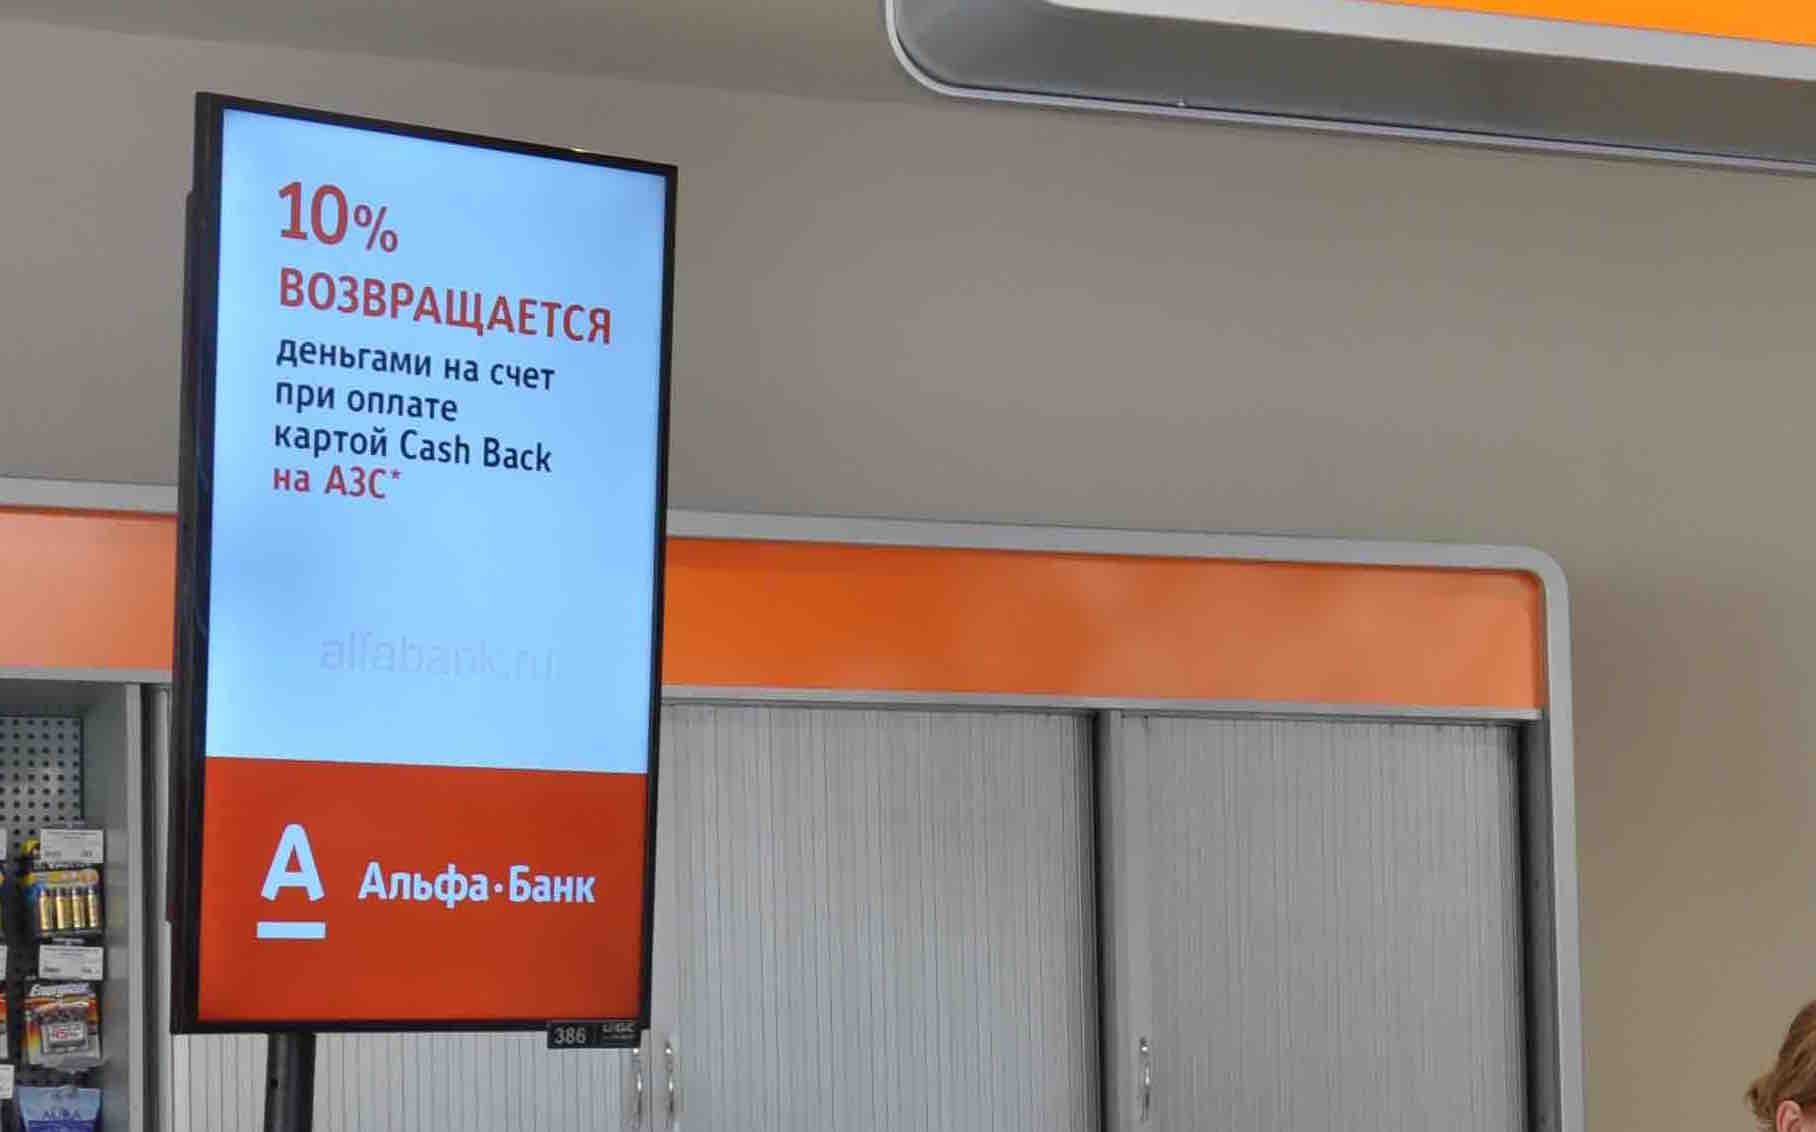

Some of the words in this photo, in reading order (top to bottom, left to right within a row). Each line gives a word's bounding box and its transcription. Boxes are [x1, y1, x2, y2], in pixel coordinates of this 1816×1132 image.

[277, 181, 398, 252] 10%
[278, 267, 613, 345] ВОЗВРАЩАЕТСЯ
[275, 338, 432, 379] деньгами
[443, 349, 480, 383] на
[490, 360, 555, 391] счет
[275, 381, 335, 416] при
[346, 390, 459, 422] оплате
[274, 423, 389, 460] картой
[399, 428, 472, 466] Cash
[482, 437, 553, 474] Back
[272, 468, 311, 493] на
